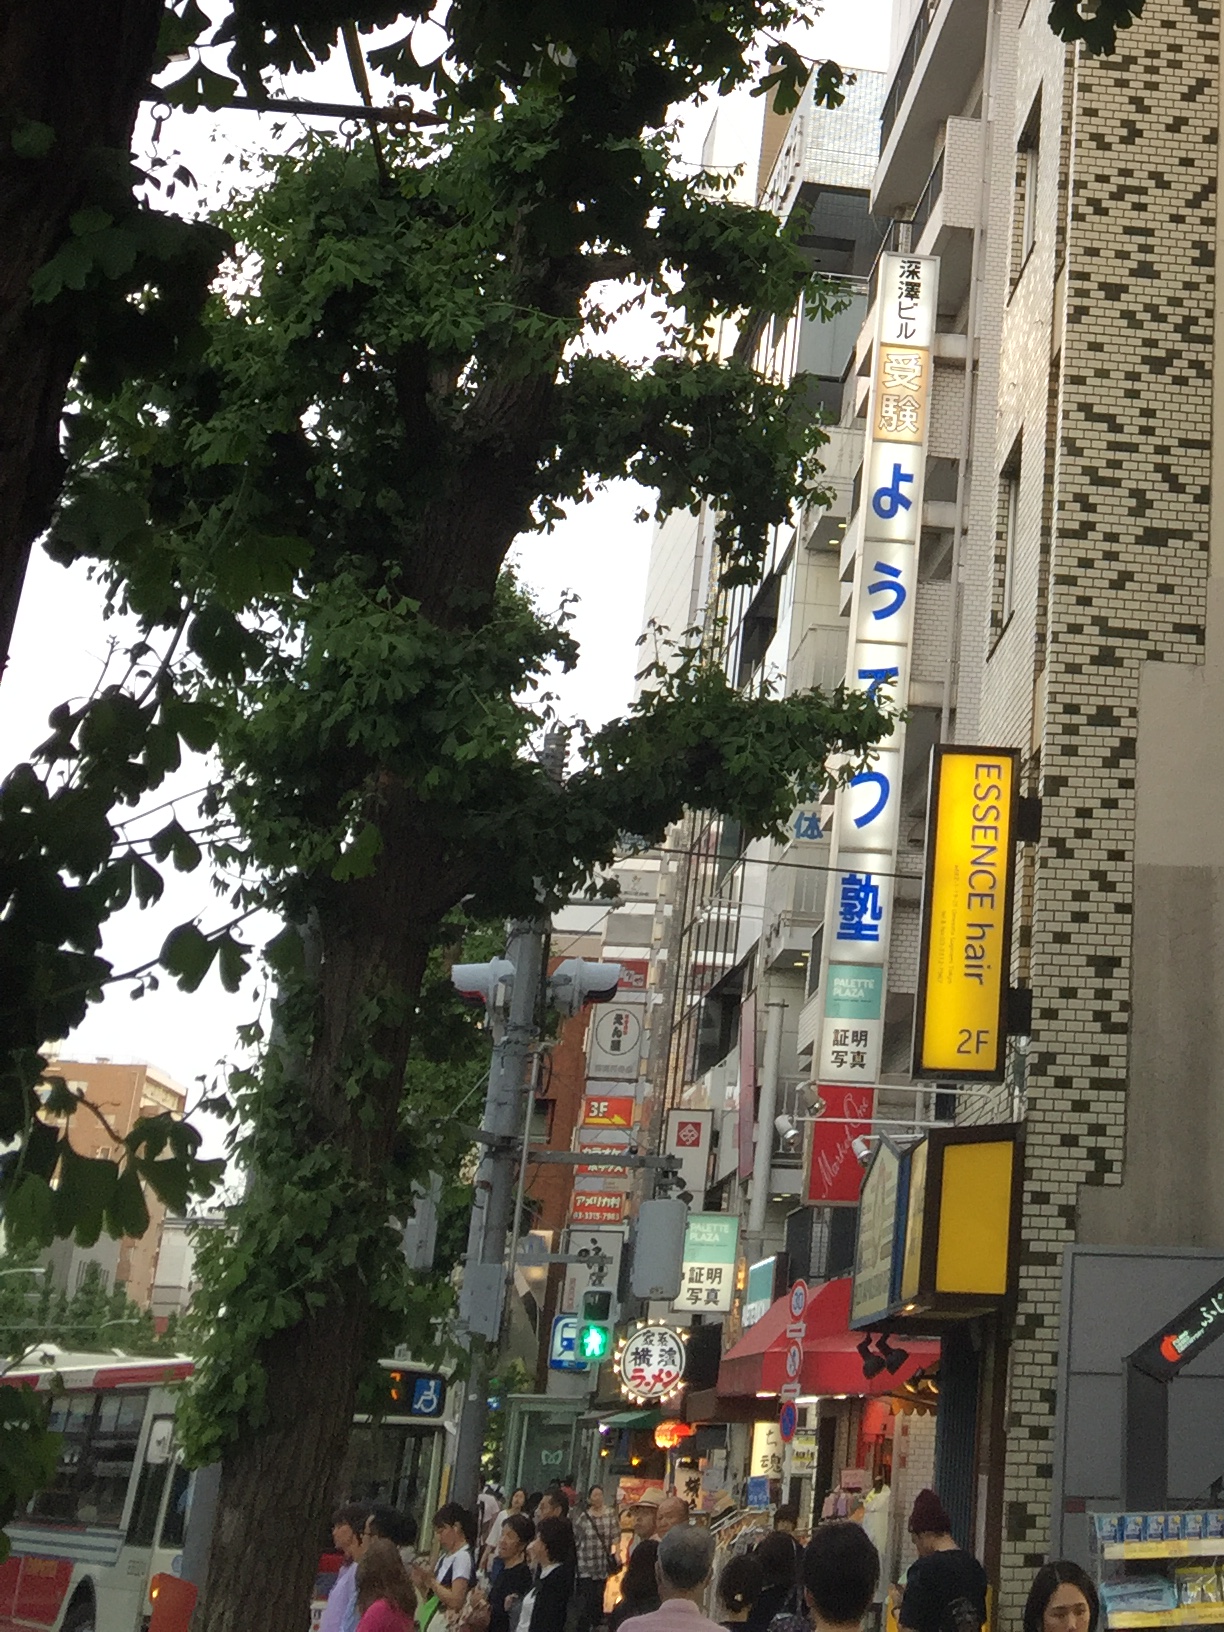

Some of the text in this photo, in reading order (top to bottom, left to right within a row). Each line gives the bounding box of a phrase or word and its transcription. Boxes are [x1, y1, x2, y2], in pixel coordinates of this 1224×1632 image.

[896, 258, 922, 340] 深澤ビル
[878, 352, 924, 434] 受験
[964, 762, 1002, 986] ESSENCE hair
[832, 987, 865, 998] PLAZA
[833, 977, 875, 989] PALETTE
[832, 1028, 869, 1048] 証明
[956, 1028, 990, 1055] 2F
[830, 1050, 867, 1069] 写真
[589, 1101, 609, 1117] 3F
[689, 1222, 730, 1234] PALETTE
[689, 1232, 720, 1242] PLAZA
[688, 1266, 723, 1285] 証明
[686, 1287, 721, 1306] 写真
[629, 1367, 680, 1393] ラーメン
